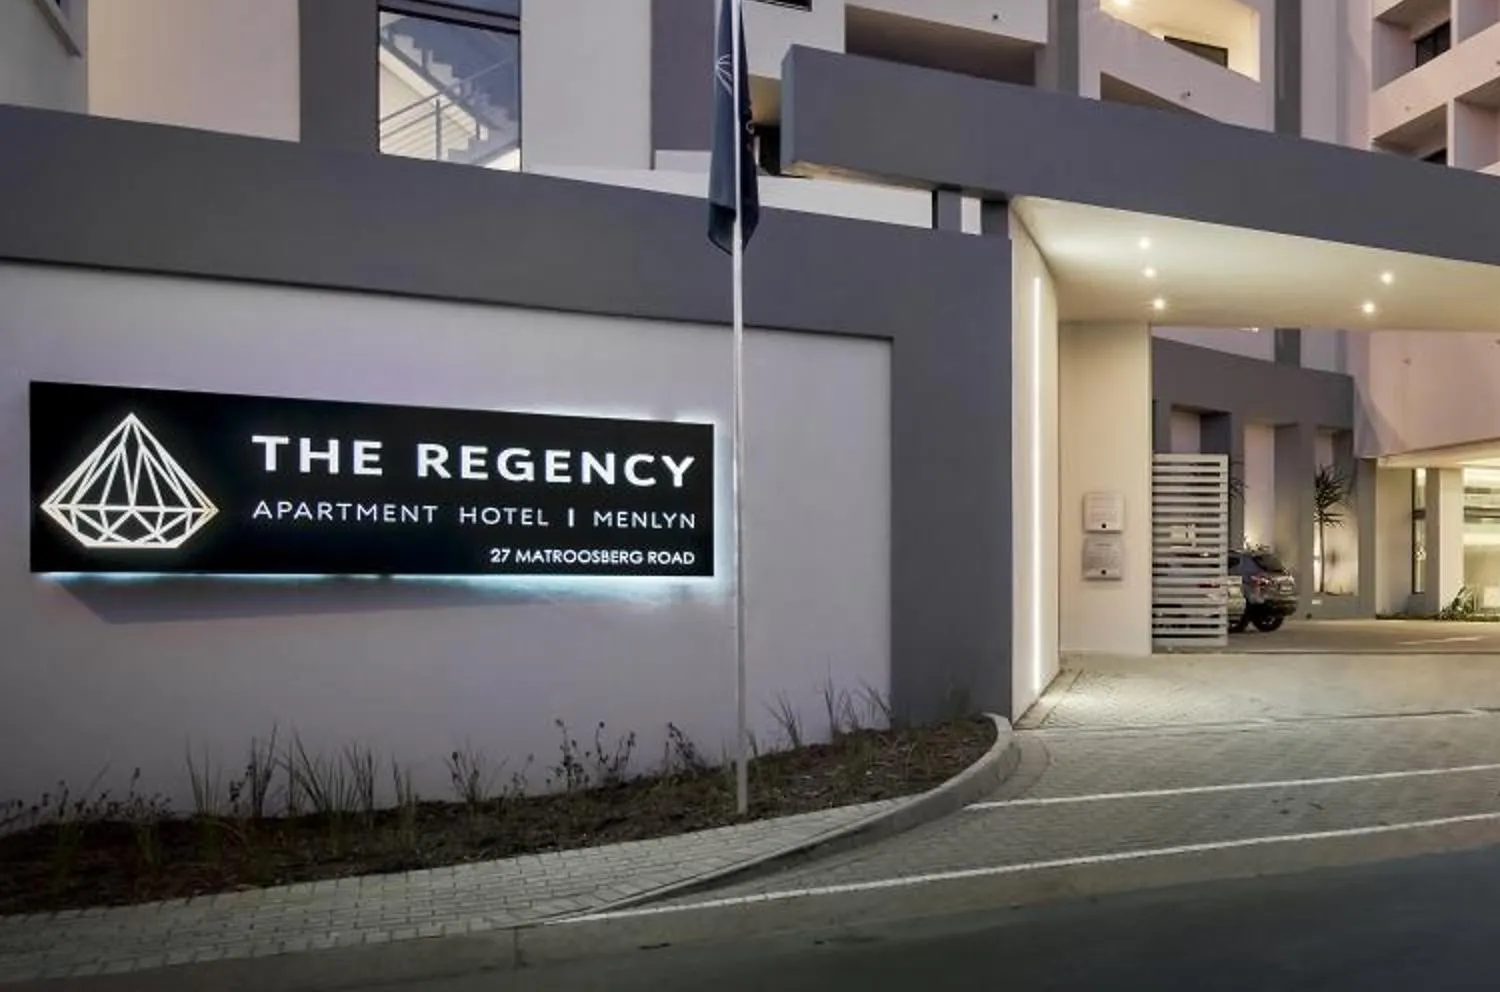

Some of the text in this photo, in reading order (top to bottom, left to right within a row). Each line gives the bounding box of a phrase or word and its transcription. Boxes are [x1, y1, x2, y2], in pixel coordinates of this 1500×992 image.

[251, 434, 696, 488] THE REGENCY
[252, 499, 439, 523] APARTMENT
[459, 506, 549, 526] HOTEL
[593, 510, 696, 529] MENLYN
[490, 547, 696, 565] 27 MATROOSBERG ROAD
